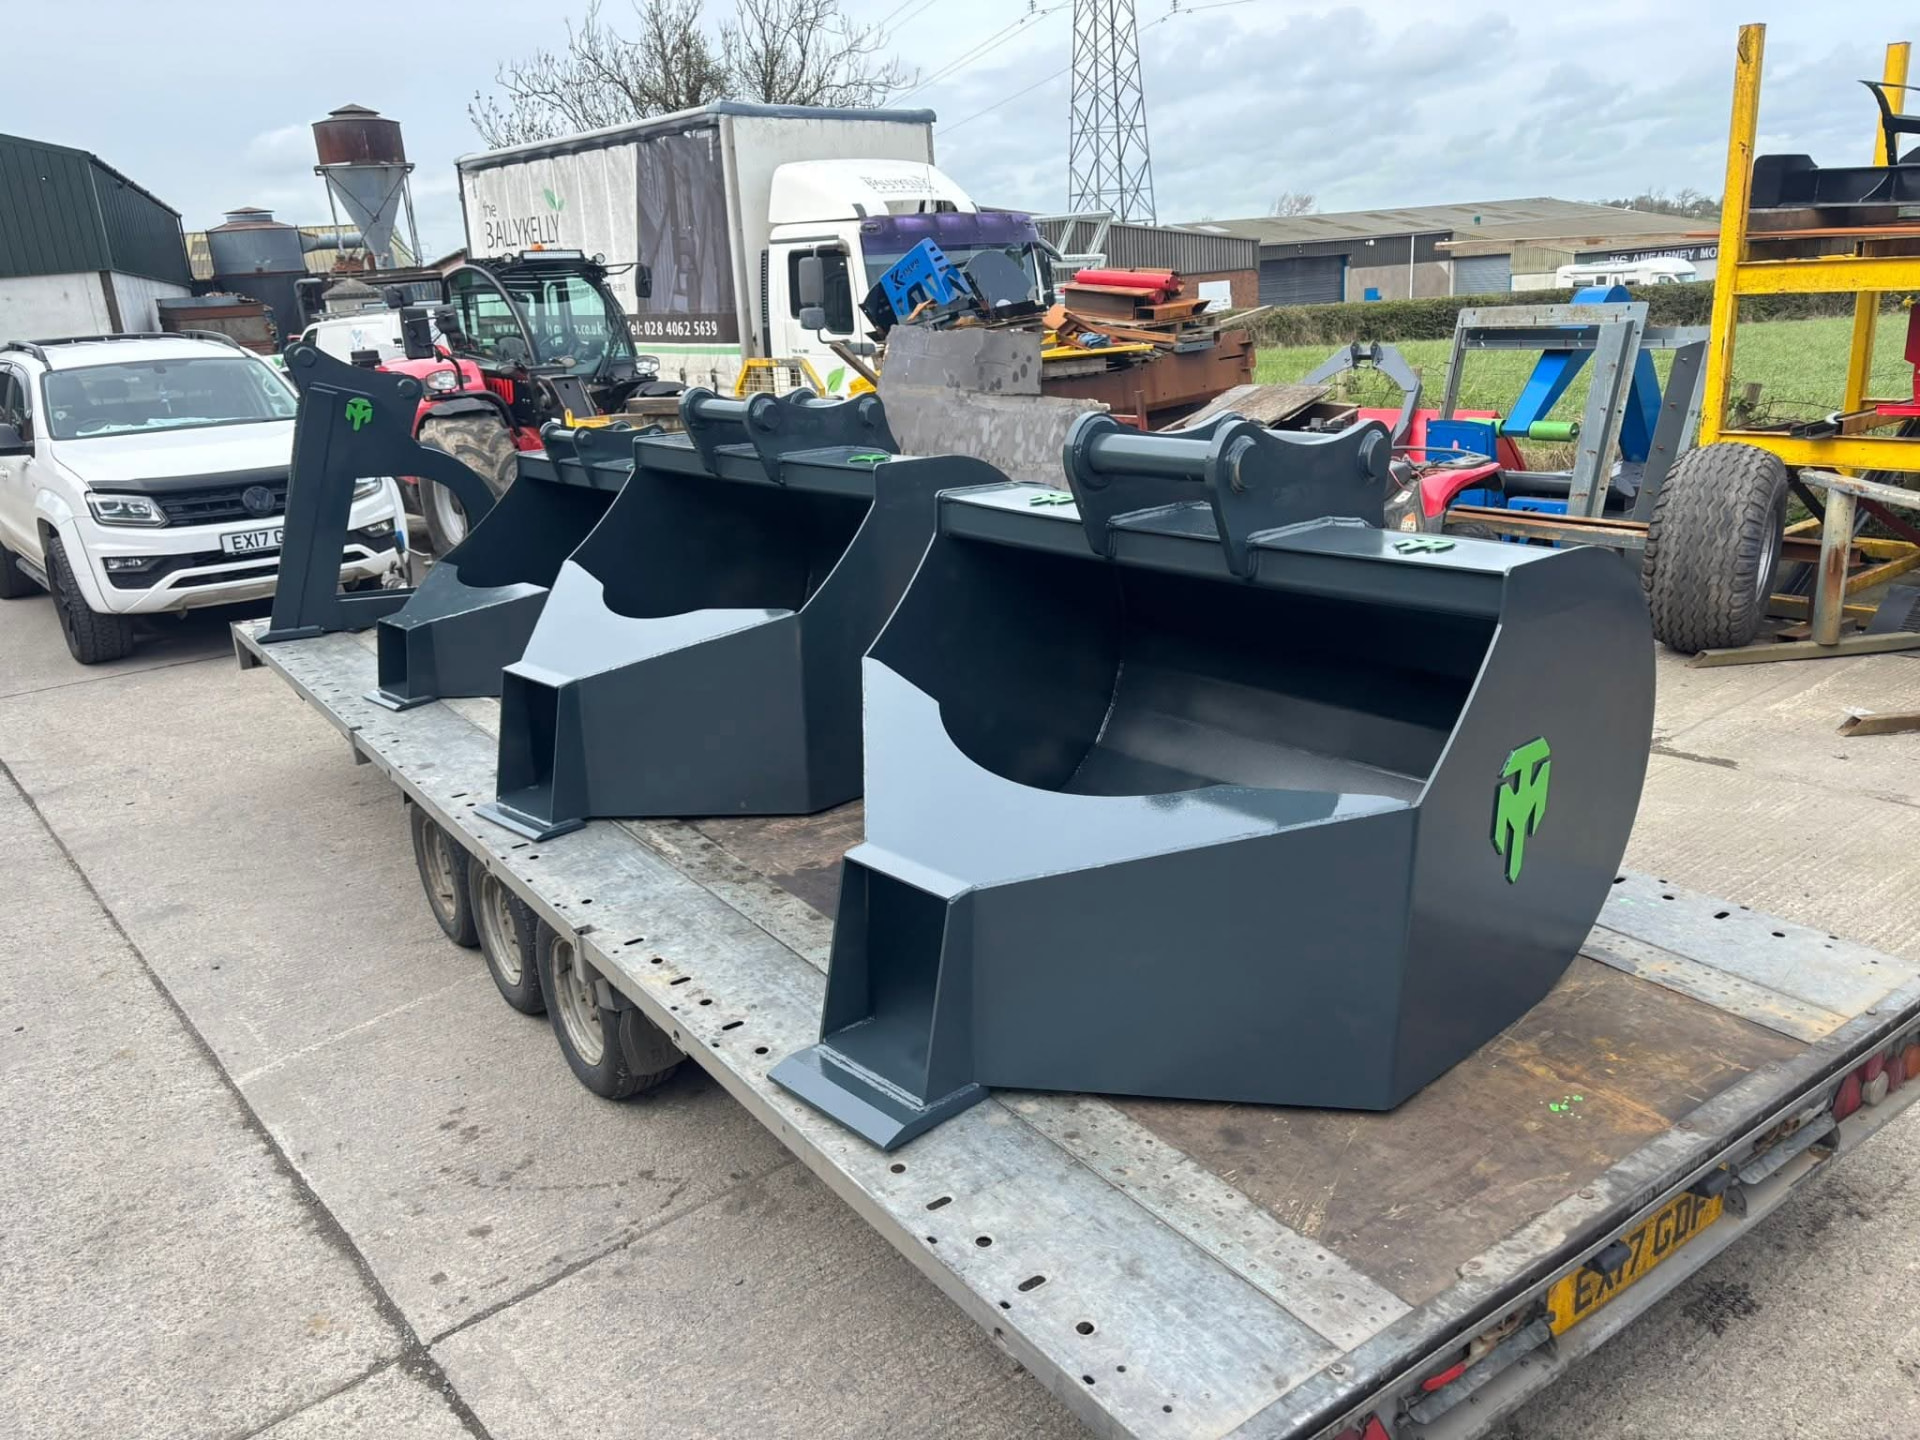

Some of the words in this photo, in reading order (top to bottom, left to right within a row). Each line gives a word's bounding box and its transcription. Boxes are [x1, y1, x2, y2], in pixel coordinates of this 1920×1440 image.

[485, 213, 559, 248] BALLYKELLY
[644, 320, 664, 336] 028
[666, 320, 692, 336] 4062
[693, 320, 718, 336] 5639
[231, 531, 268, 550] EX17
